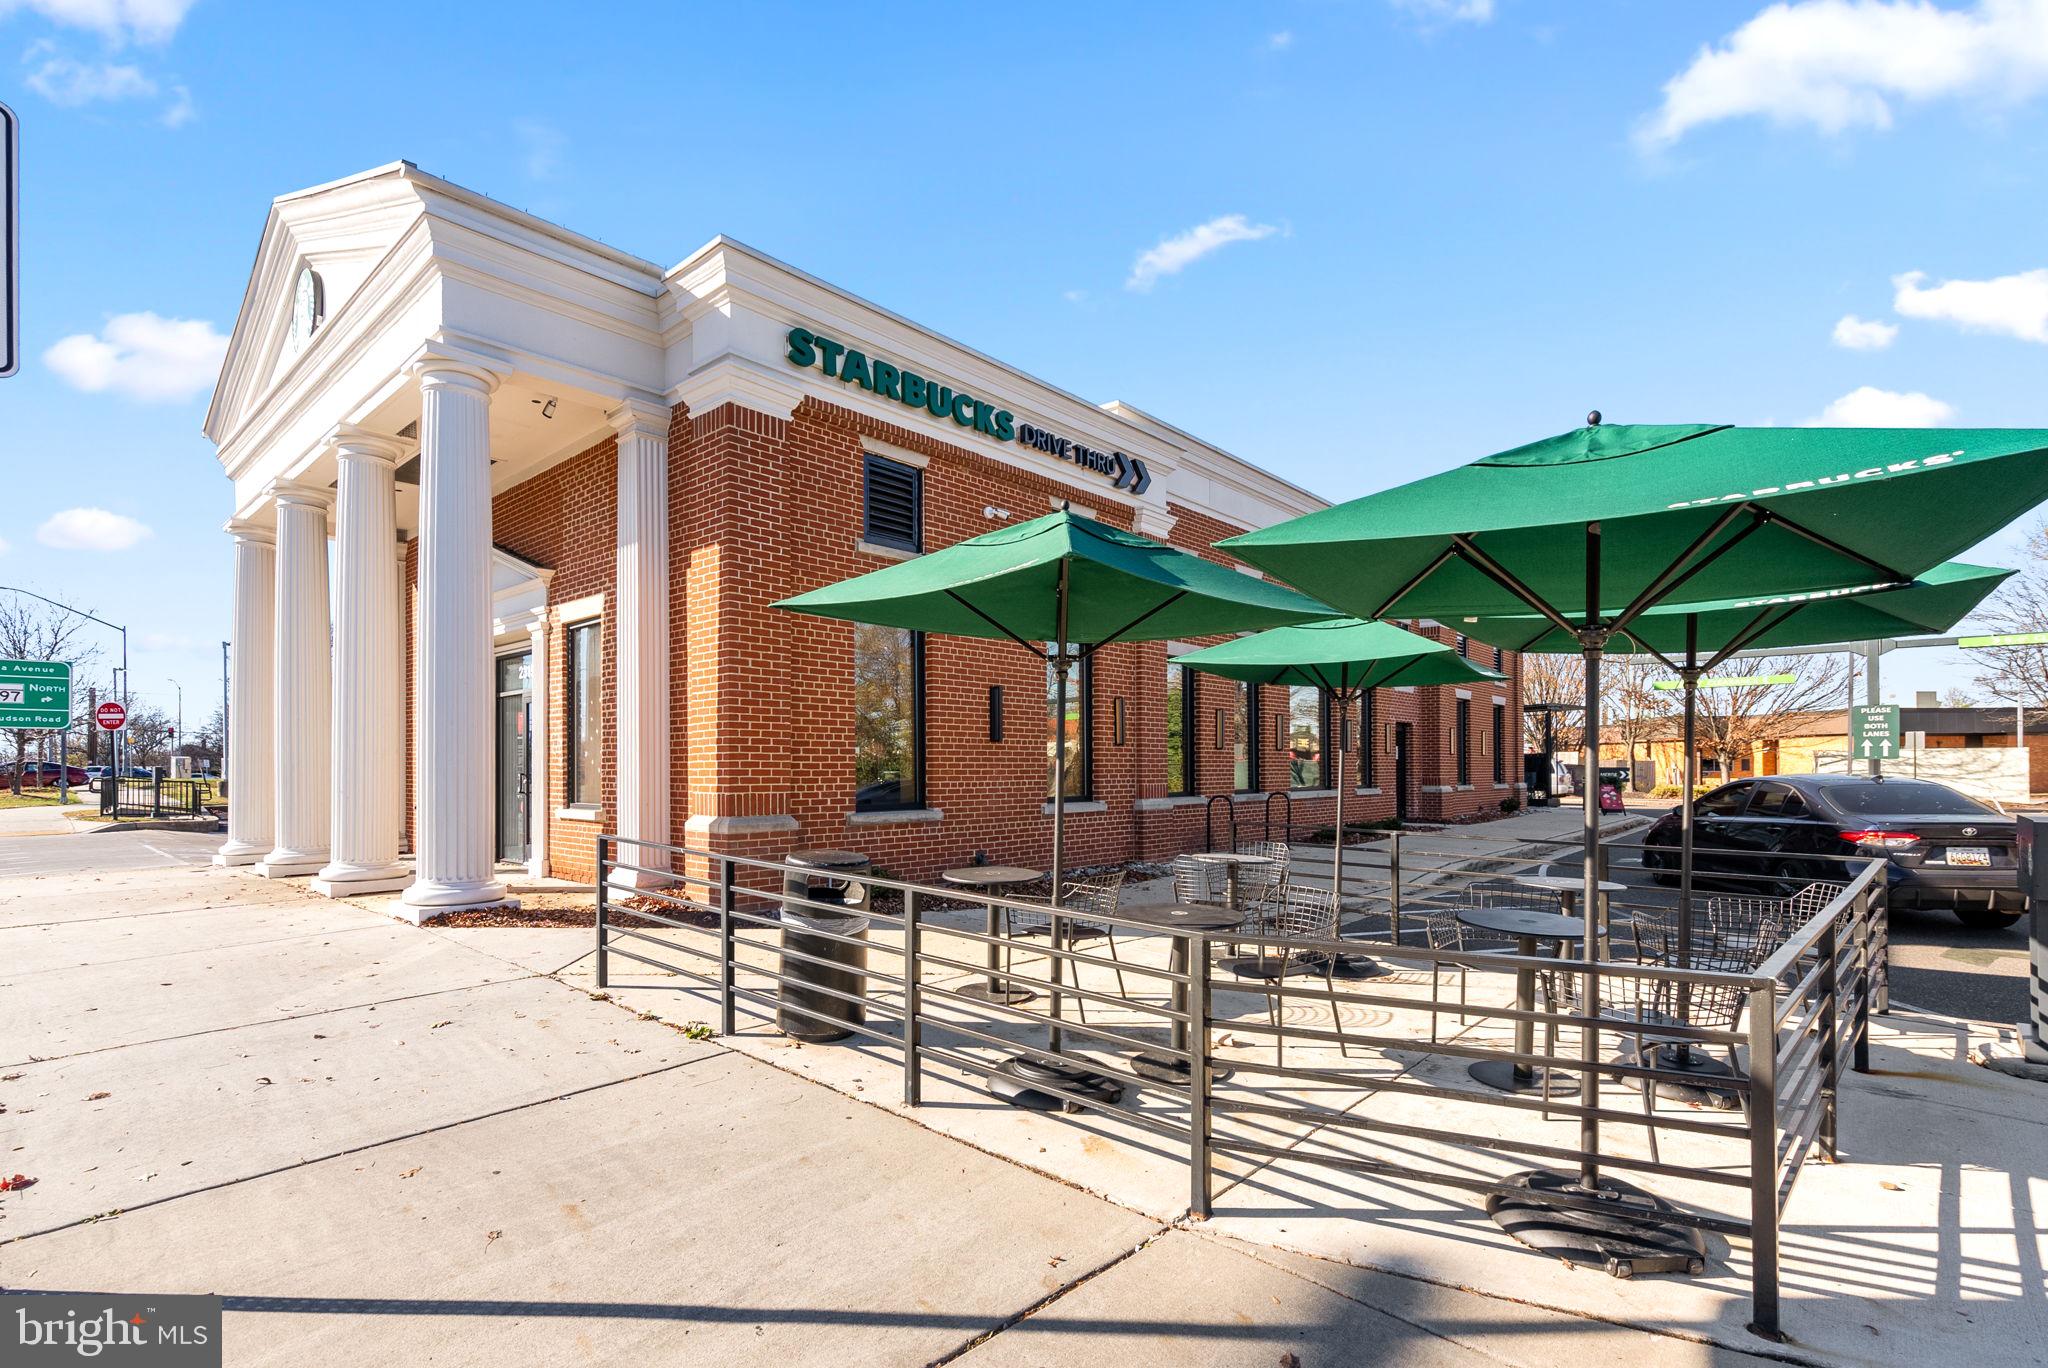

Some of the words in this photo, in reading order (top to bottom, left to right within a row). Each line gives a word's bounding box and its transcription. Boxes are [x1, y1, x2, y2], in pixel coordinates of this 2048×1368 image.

[787, 327, 1016, 442] STARBUCKS
[1019, 423, 1073, 460] DRIVE
[1072, 443, 1116, 475] THRU
[13, 665, 55, 673] Avenue
[29, 683, 66, 693] NORTH
[1860, 706, 1892, 714] PLEASE
[34, 715, 61, 723] Road
